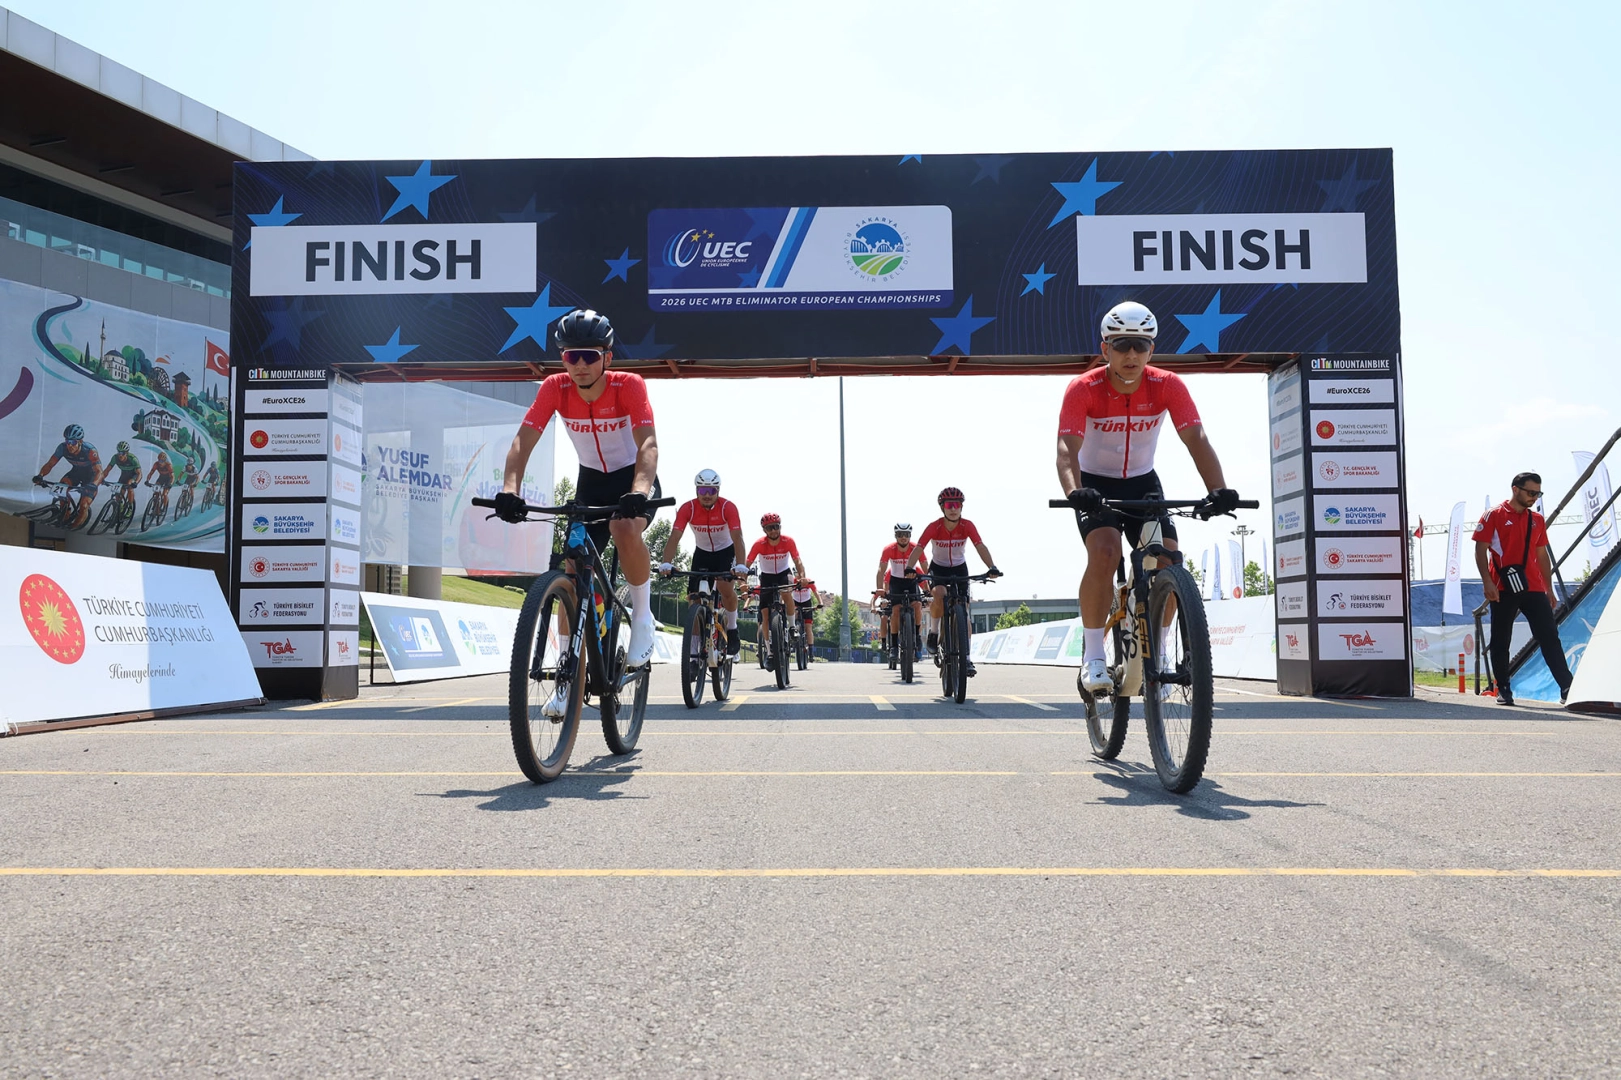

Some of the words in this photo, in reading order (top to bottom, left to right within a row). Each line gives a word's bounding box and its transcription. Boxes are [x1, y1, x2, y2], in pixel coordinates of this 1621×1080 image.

[855, 217, 898, 229] SAKARYA
[703, 241, 752, 258] UEC
[1133, 229, 1311, 271] FINISH
[305, 239, 482, 282] FINISH
[661, 298, 686, 306] 2026
[689, 298, 709, 306] UEC
[711, 297, 733, 305] MTB
[736, 296, 798, 305] ELIMINATOR
[800, 296, 855, 304] EUROPEAN
[857, 295, 941, 304] CHAMPIONSHIPS
[1333, 359, 1390, 369] MOUNTAINBIKE
[270, 369, 326, 379] MOUNTAINBIKE
[1326, 387, 1371, 395] #EuroXCE26
[565, 418, 627, 433] TÜRKİYE
[1093, 417, 1160, 433] TÜRKİYE
[378, 445, 430, 469] YUSUF
[377, 465, 453, 490] ALEMDAR
[53, 486, 64, 494] 21
[410, 494, 438, 503] BAŞKANI
[82, 596, 135, 617] TÜRKİYE
[135, 600, 205, 619] CUMHURİYETİ
[94, 625, 215, 646] CUMHURBAŞKANLIĞI
[1339, 630, 1377, 651] TGA
[260, 638, 297, 658] TGA
[108, 662, 176, 684] Himayelerinde
